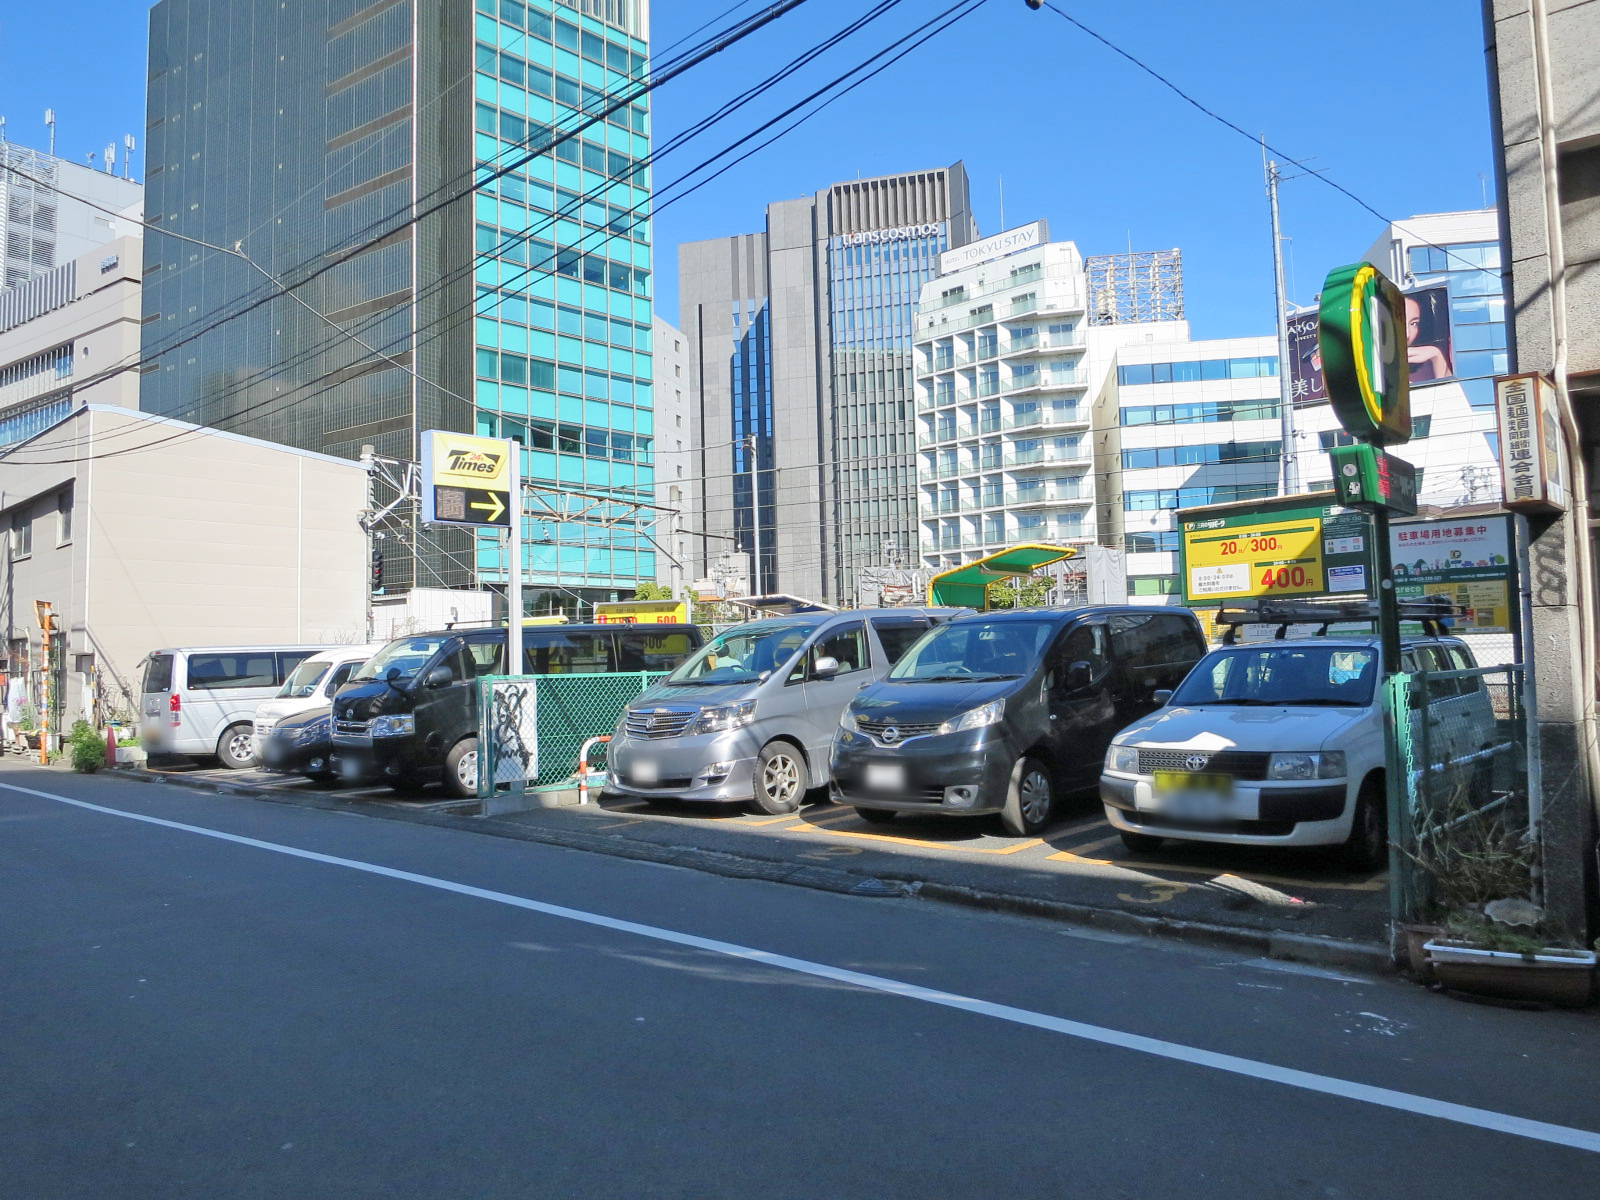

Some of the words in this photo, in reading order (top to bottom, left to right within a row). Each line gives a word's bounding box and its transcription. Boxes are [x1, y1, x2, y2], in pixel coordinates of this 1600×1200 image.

[944, 256, 961, 265] HOTEL
[963, 240, 1003, 261] TOKYU
[1004, 228, 1035, 249] STAY
[1291, 378, 1325, 398] 美し
[448, 454, 496, 473] Times
[1398, 525, 1487, 541] 駐車場用地募集中
